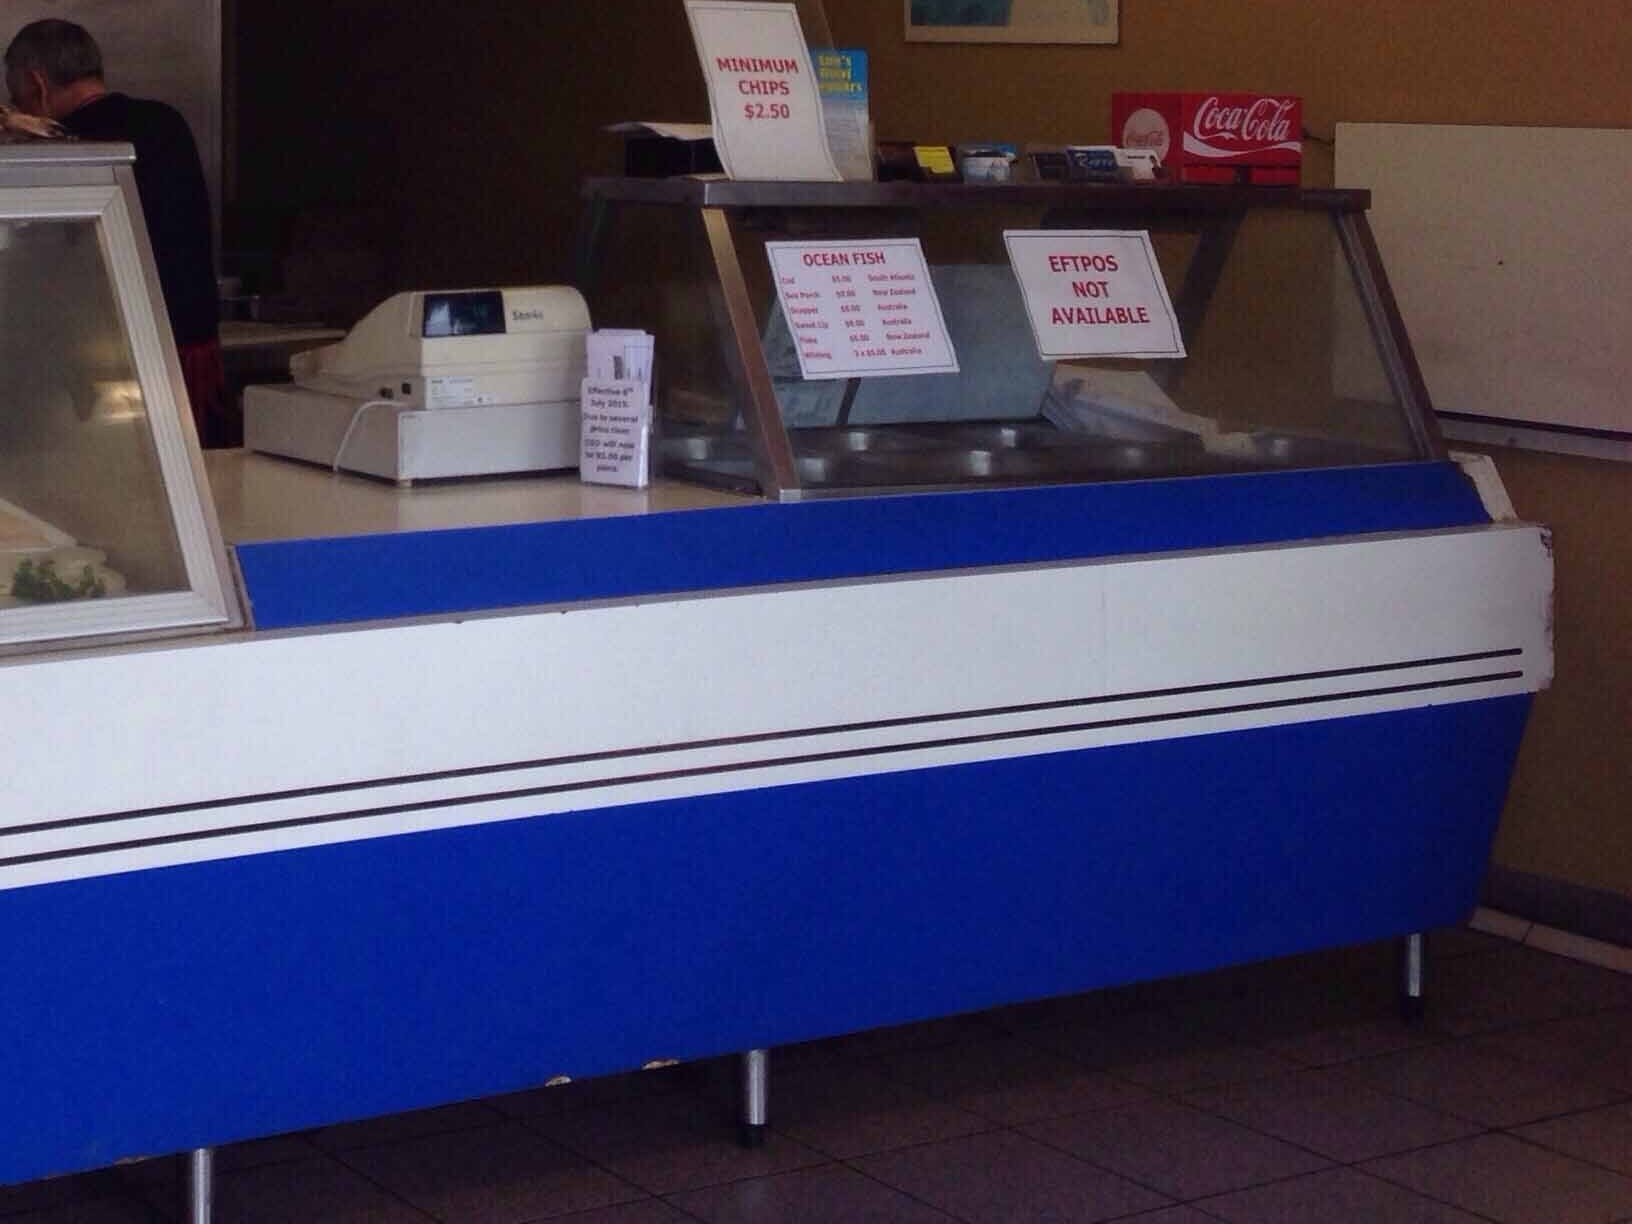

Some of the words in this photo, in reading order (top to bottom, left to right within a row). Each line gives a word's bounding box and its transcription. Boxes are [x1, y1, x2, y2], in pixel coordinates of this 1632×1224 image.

[716, 57, 799, 74] MINIMUM
[739, 80, 790, 95] CHIPS
[744, 103, 790, 119] $2.50
[1194, 97, 1296, 142] Coca-Cola
[803, 252, 850, 267] OCEAN
[852, 251, 886, 265] FISH
[1048, 254, 1119, 273] EFTPOS
[1072, 281, 1109, 299] NOT
[1051, 306, 1151, 326] AVAILABLE
